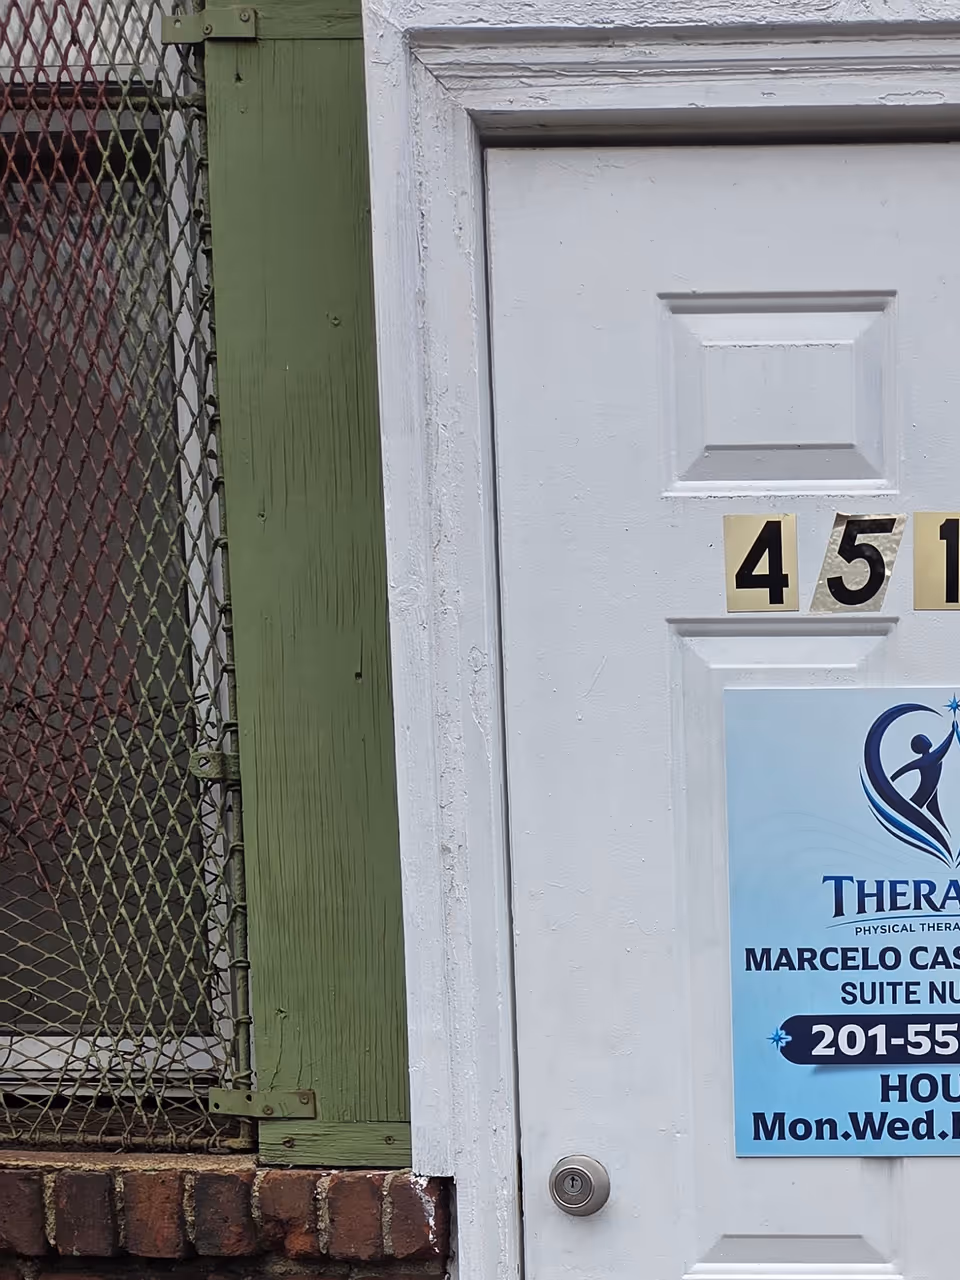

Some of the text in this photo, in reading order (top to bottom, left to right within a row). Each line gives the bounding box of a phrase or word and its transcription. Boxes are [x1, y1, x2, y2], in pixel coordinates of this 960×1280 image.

[855, 923, 915, 936] PHYSICAL
[745, 946, 901, 971] MARCELO
[841, 981, 920, 1004] SUITE
